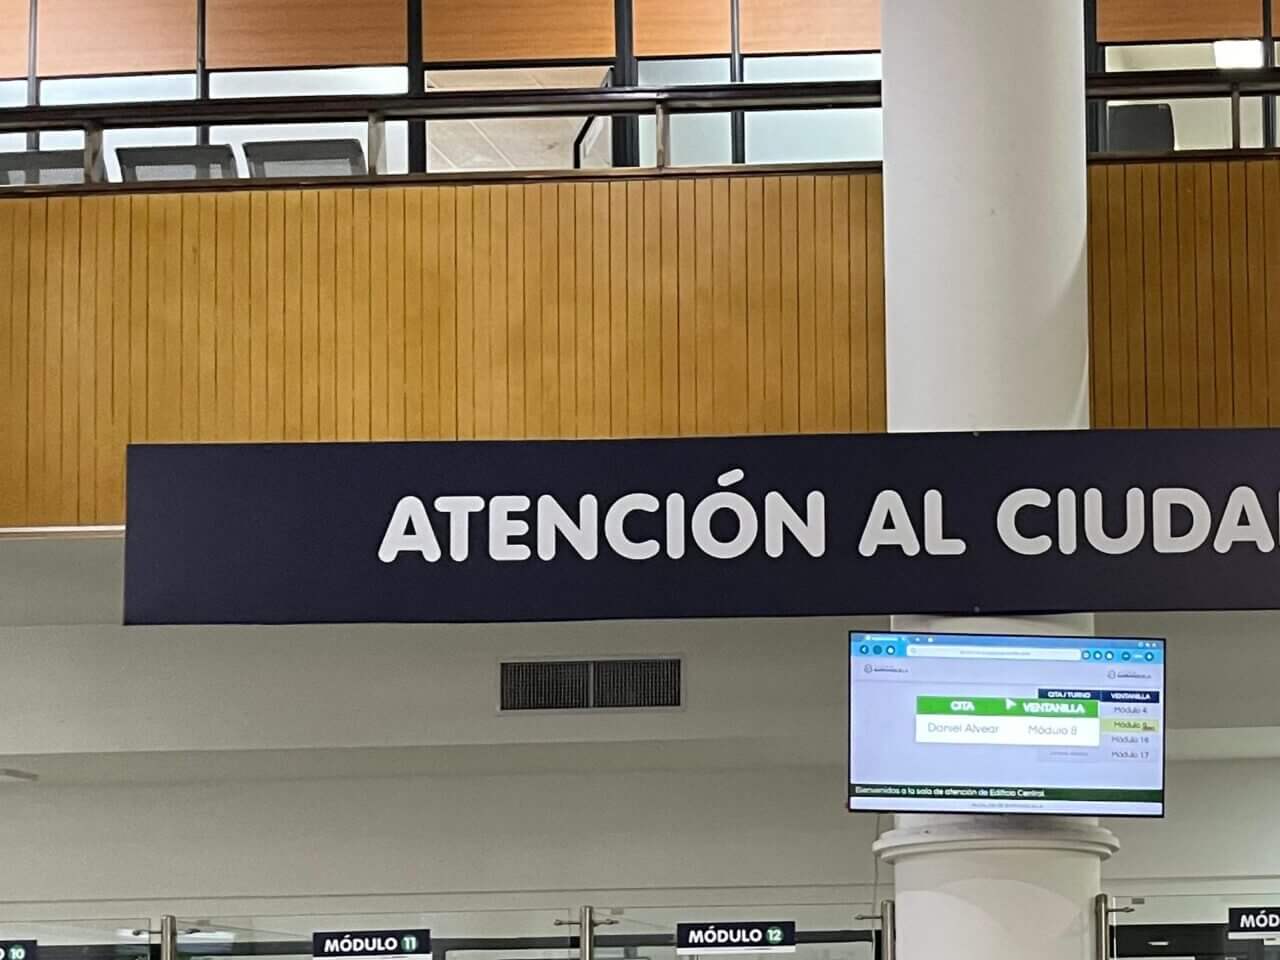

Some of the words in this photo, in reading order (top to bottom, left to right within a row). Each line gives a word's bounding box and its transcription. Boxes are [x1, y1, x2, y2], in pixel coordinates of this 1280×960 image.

[377, 468, 826, 563] ATENCIÓN
[858, 489, 967, 557] AL
[950, 700, 975, 711] CITA
[1022, 702, 1085, 714] VENTANILLA
[927, 722, 962, 734] Daniel
[965, 723, 1000, 734] Alvear
[1028, 725, 1069, 736] Módulo
[688, 924, 763, 944] MÓDULO
[766, 928, 782, 942] 12
[324, 934, 398, 953] MÓDULO
[402, 936, 417, 951] 11
[9, 947, 26, 960] 10
